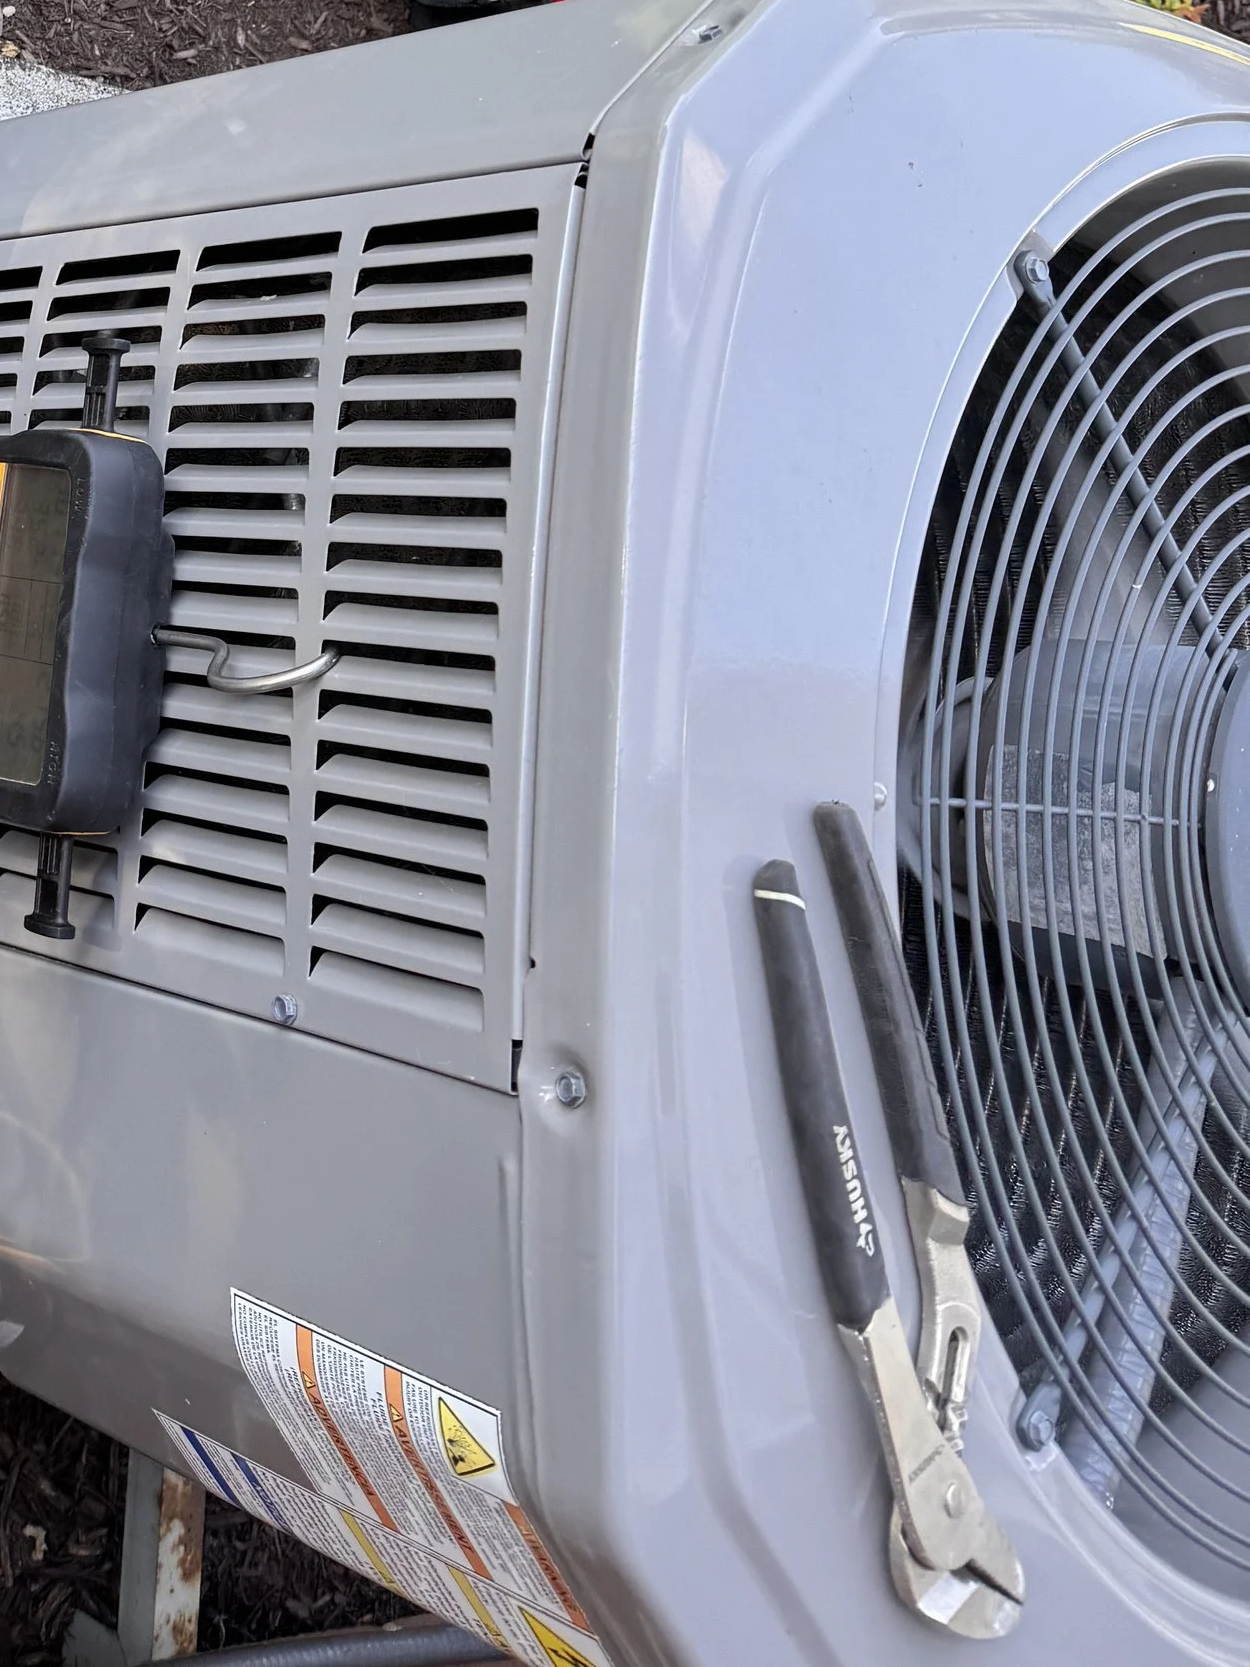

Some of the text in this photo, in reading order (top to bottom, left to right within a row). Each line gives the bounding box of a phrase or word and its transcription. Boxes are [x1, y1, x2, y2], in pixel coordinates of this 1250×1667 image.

[832, 1125, 868, 1224] HUSKY
[309, 1392, 375, 1496] ADVERTENCIA
[395, 1425, 475, 1551] AVERTISSEMENT
